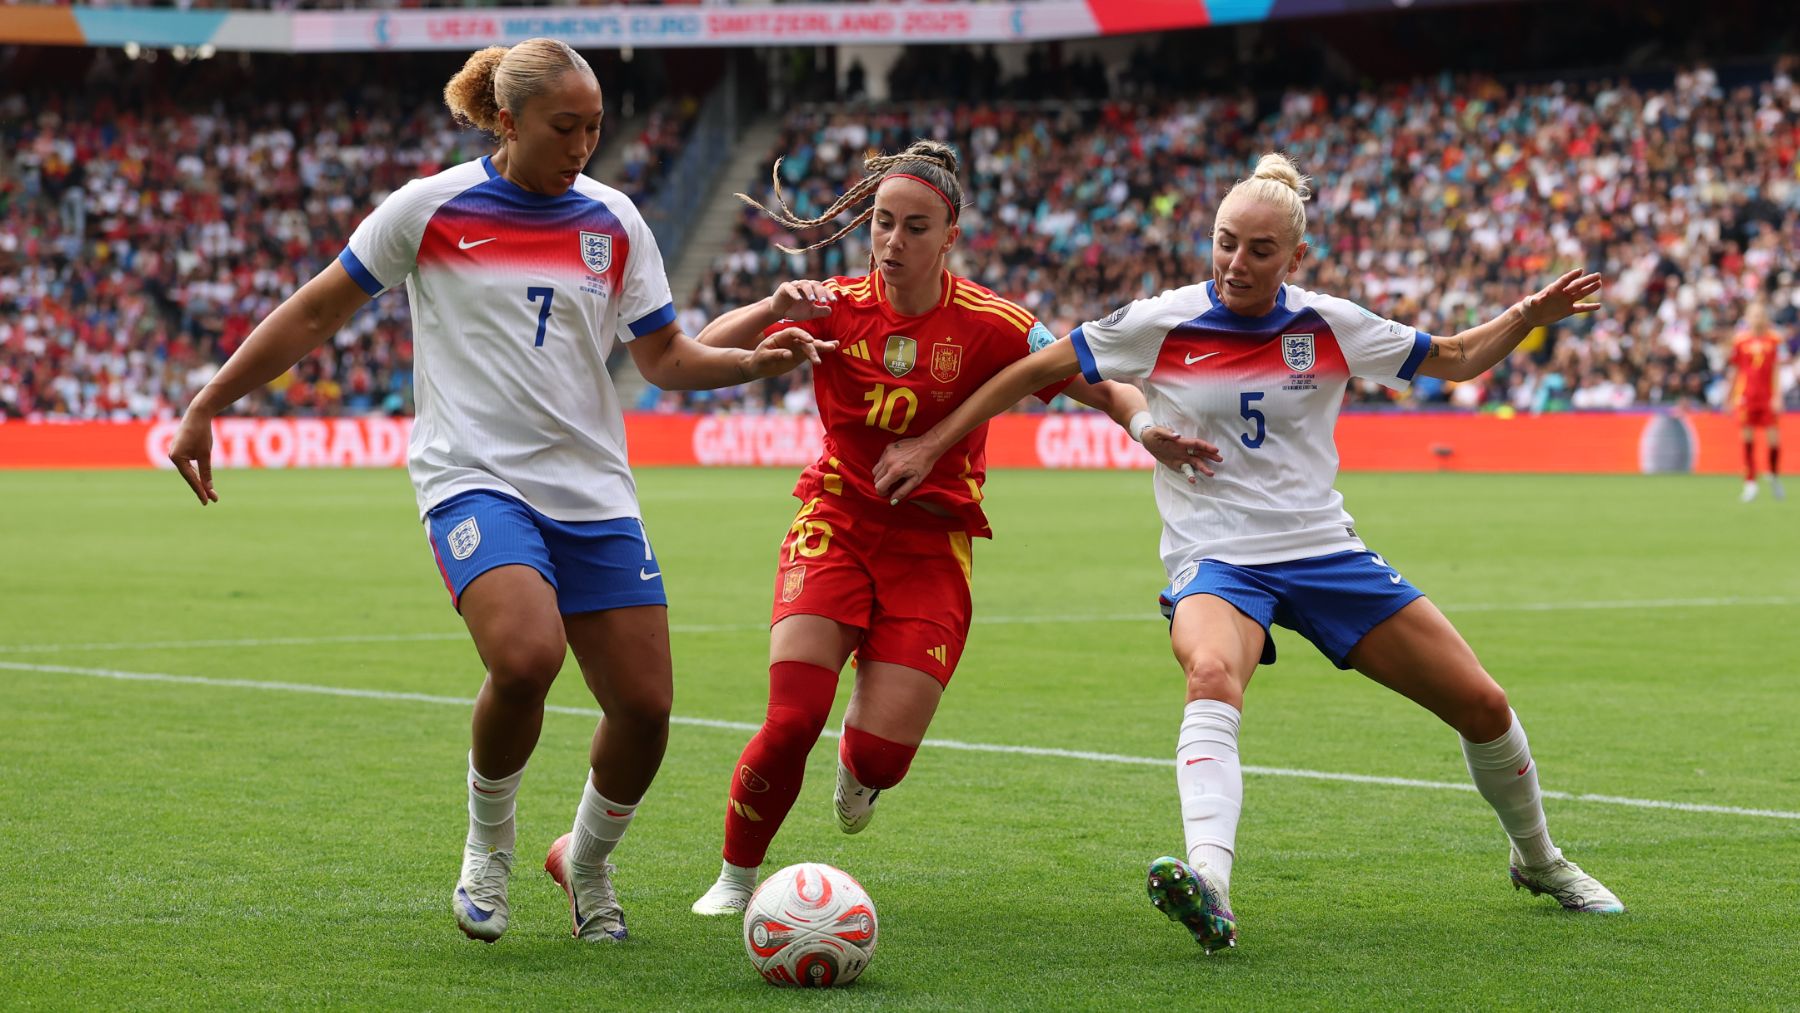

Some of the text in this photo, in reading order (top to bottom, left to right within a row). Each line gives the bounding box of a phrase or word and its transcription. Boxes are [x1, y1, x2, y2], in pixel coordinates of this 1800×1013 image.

[426, 11, 972, 41] UEFA WOMEN'S EURO SWITZERLAND 2025
[527, 287, 554, 347] 7
[864, 383, 918, 435] 10
[1240, 392, 1265, 448] 5
[789, 517, 833, 562] 10
